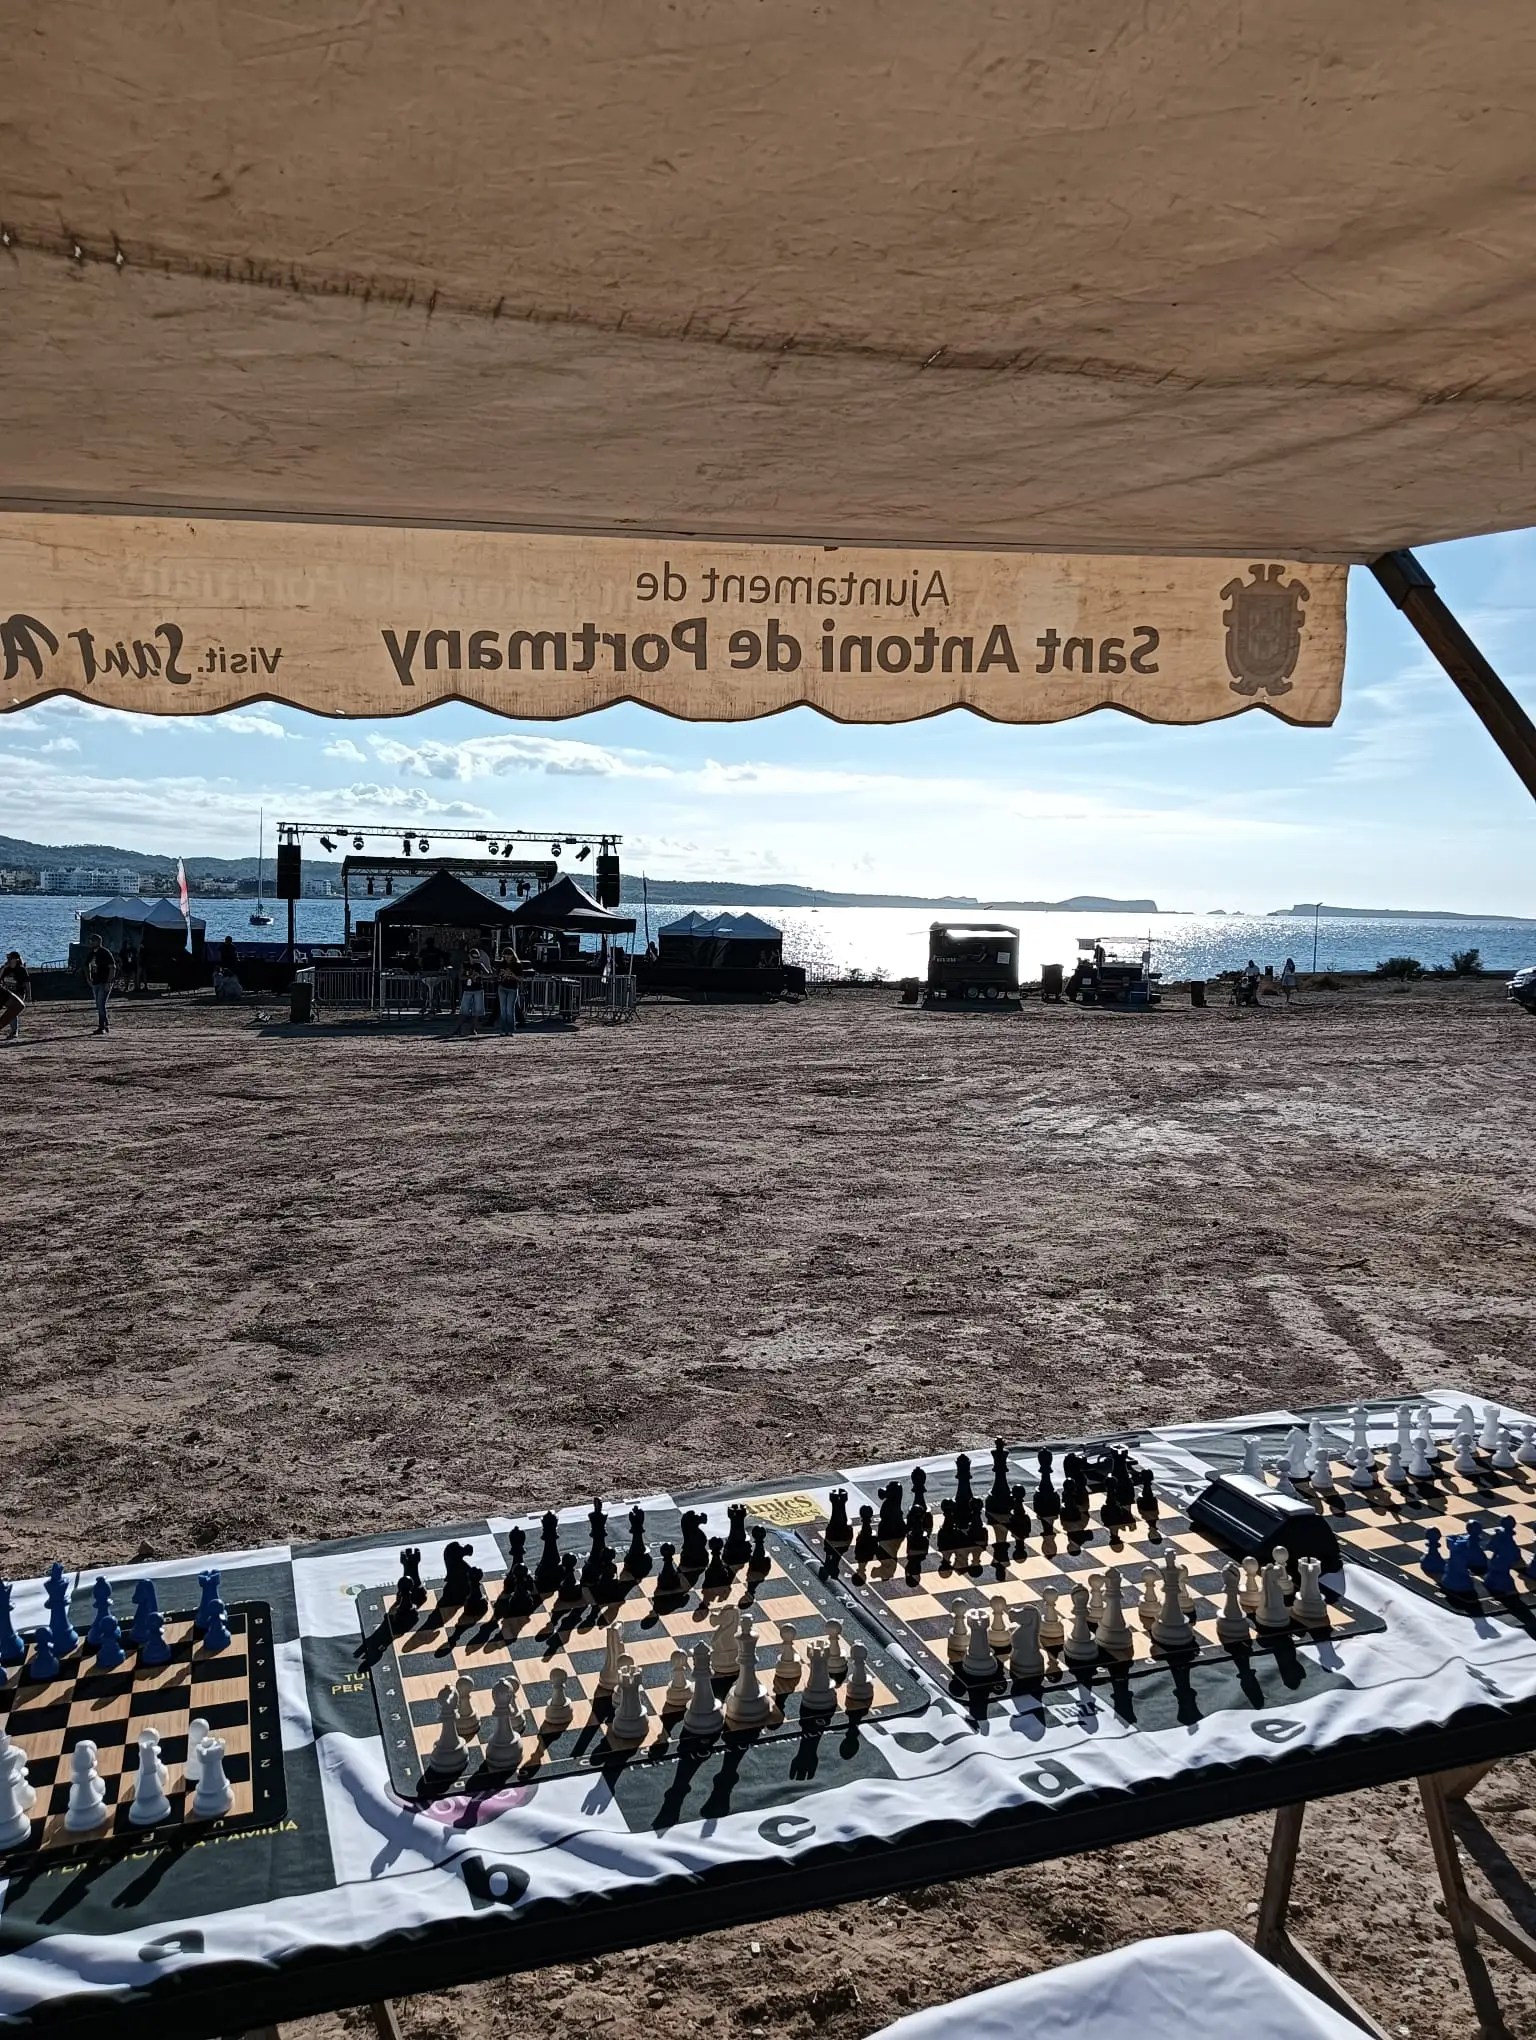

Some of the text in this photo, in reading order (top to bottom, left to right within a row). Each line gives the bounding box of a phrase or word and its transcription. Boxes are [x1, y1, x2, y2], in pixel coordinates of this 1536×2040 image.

[331, 1682, 364, 1695] PER
[386, 1688, 396, 1696] 4
[391, 1713, 401, 1721] 3
[397, 1740, 408, 1748] 2
[404, 1768, 412, 1776] 1
[1250, 1717, 1307, 1743] e
[261, 1758, 271, 1768] 2
[1018, 1758, 1087, 1798] d
[757, 1815, 817, 1847] c
[461, 1855, 531, 1911] b
